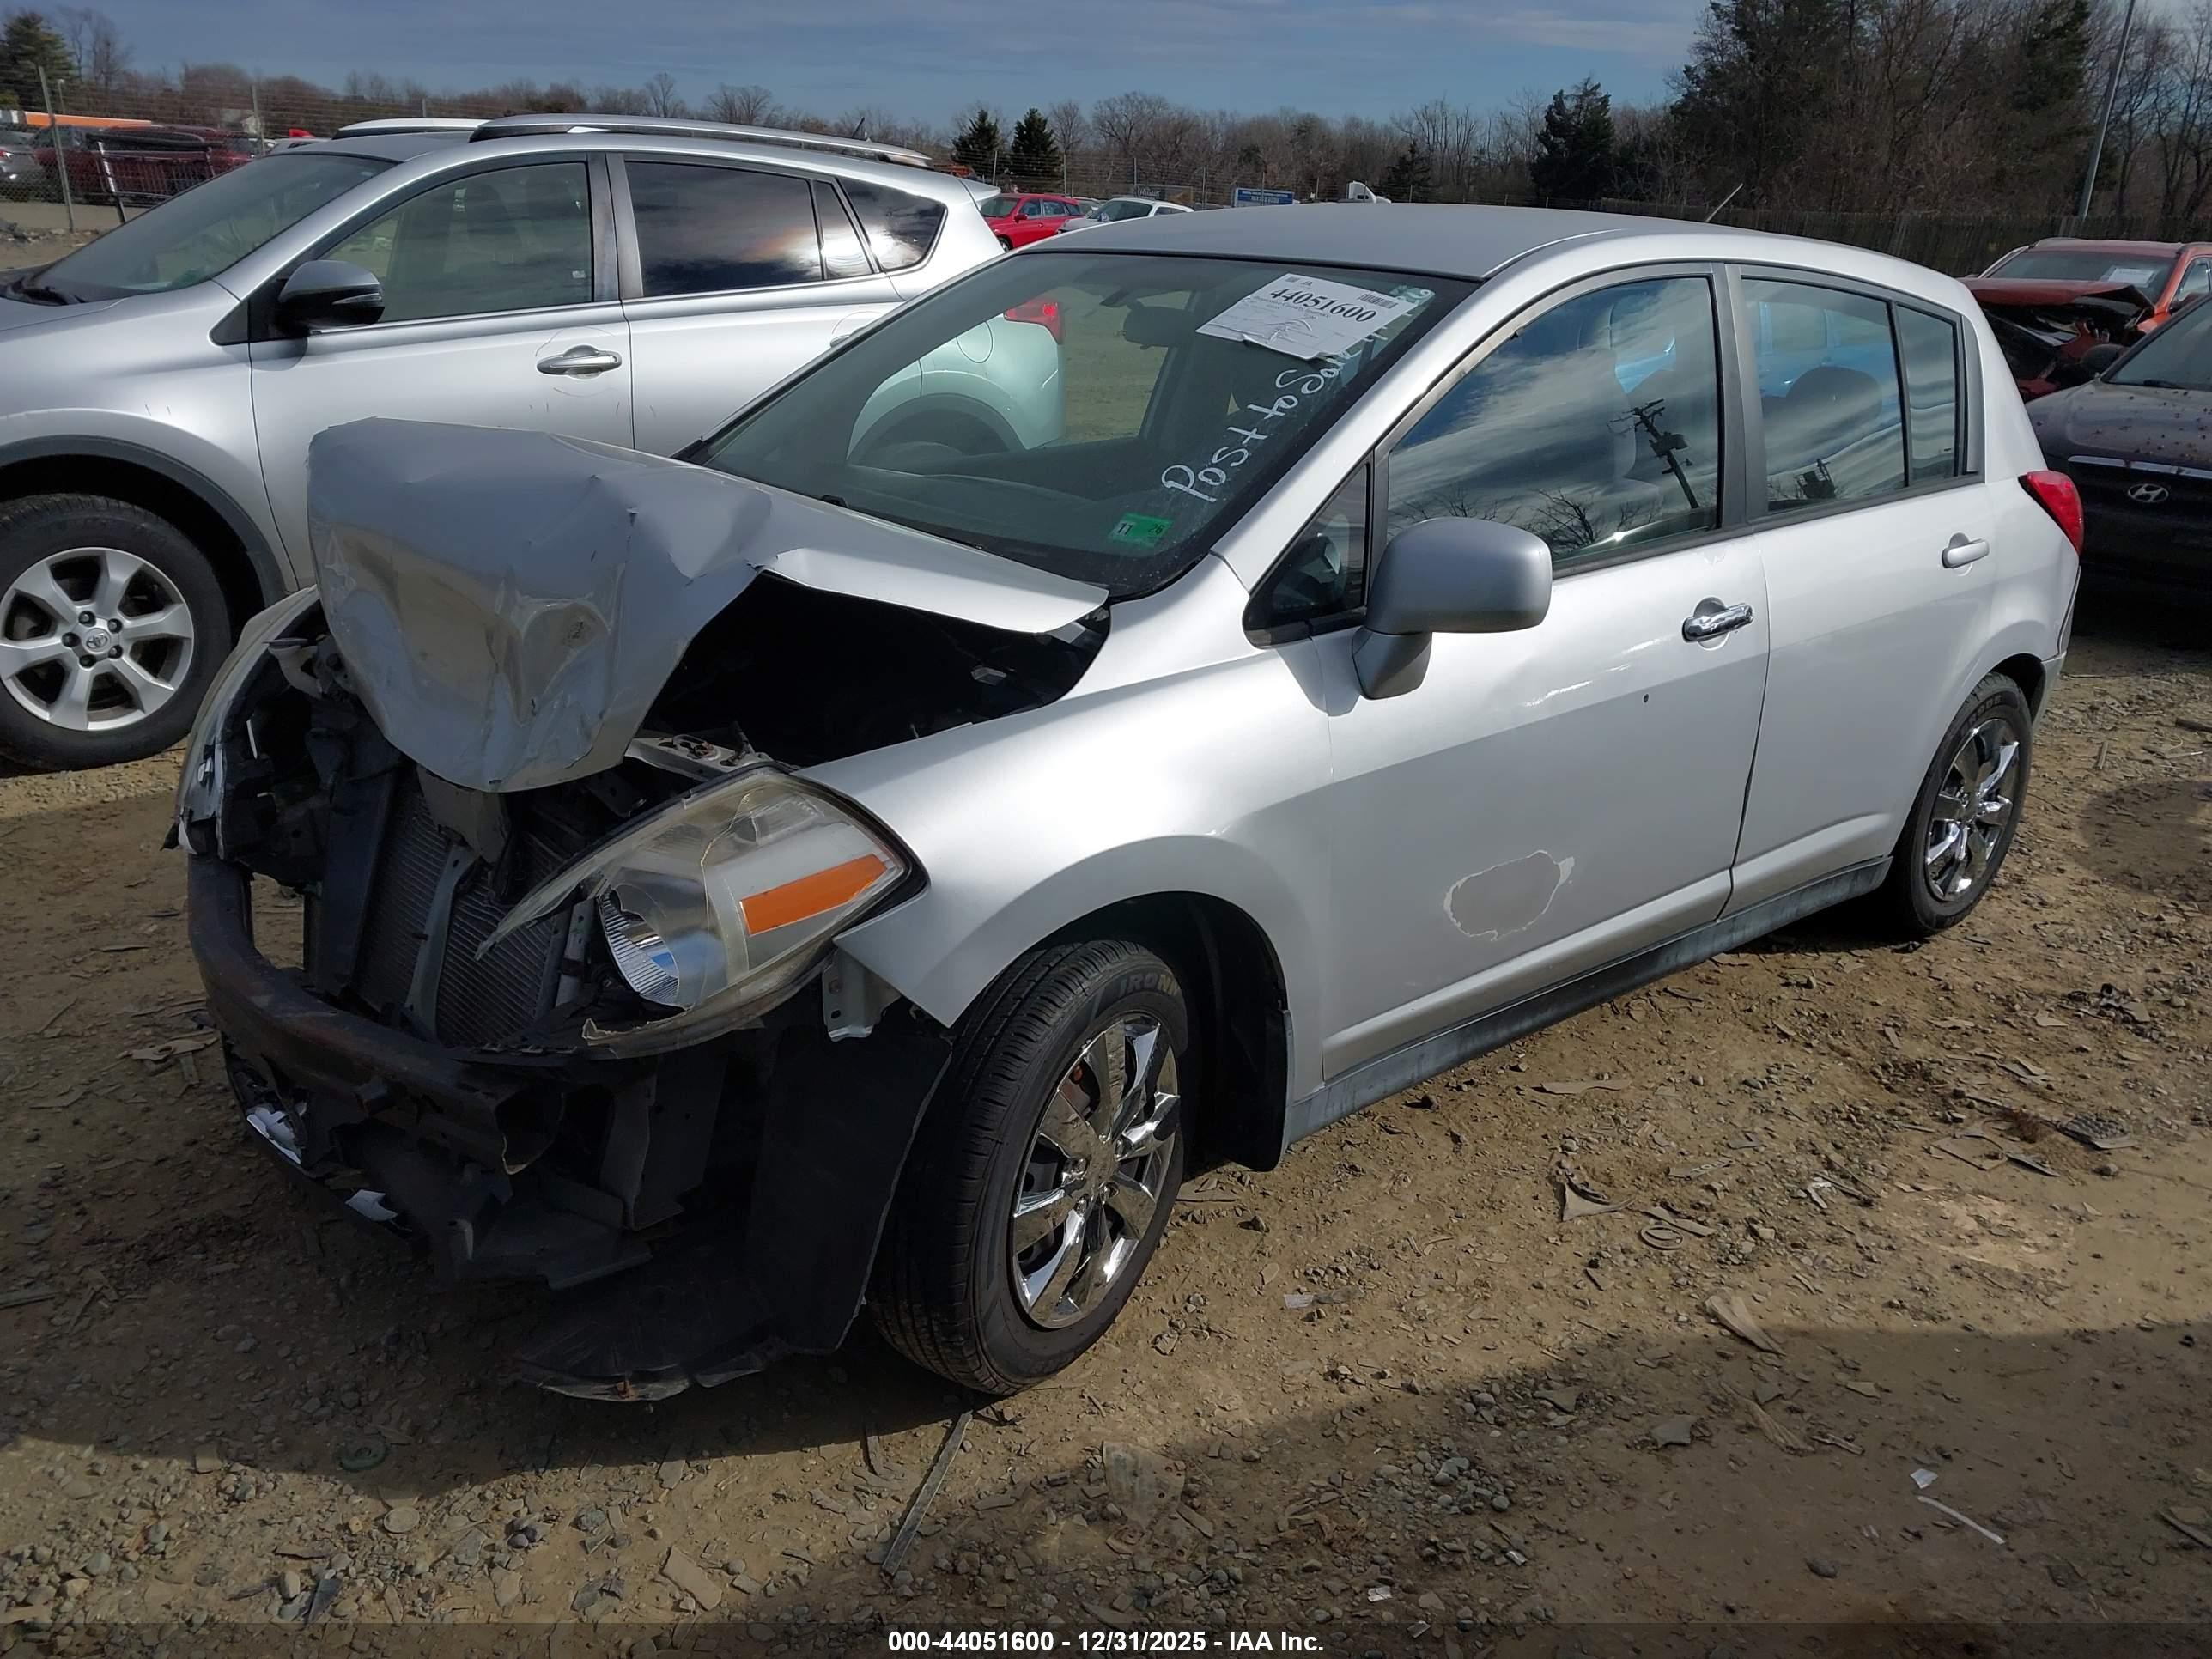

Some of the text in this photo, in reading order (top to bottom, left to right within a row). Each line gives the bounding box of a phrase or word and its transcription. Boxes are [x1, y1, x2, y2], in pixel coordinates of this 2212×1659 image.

[1270, 288, 1377, 322] 44051600
[1161, 426, 1268, 503] Post
[1247, 394, 1298, 420] to
[1118, 523, 1134, 536] 11
